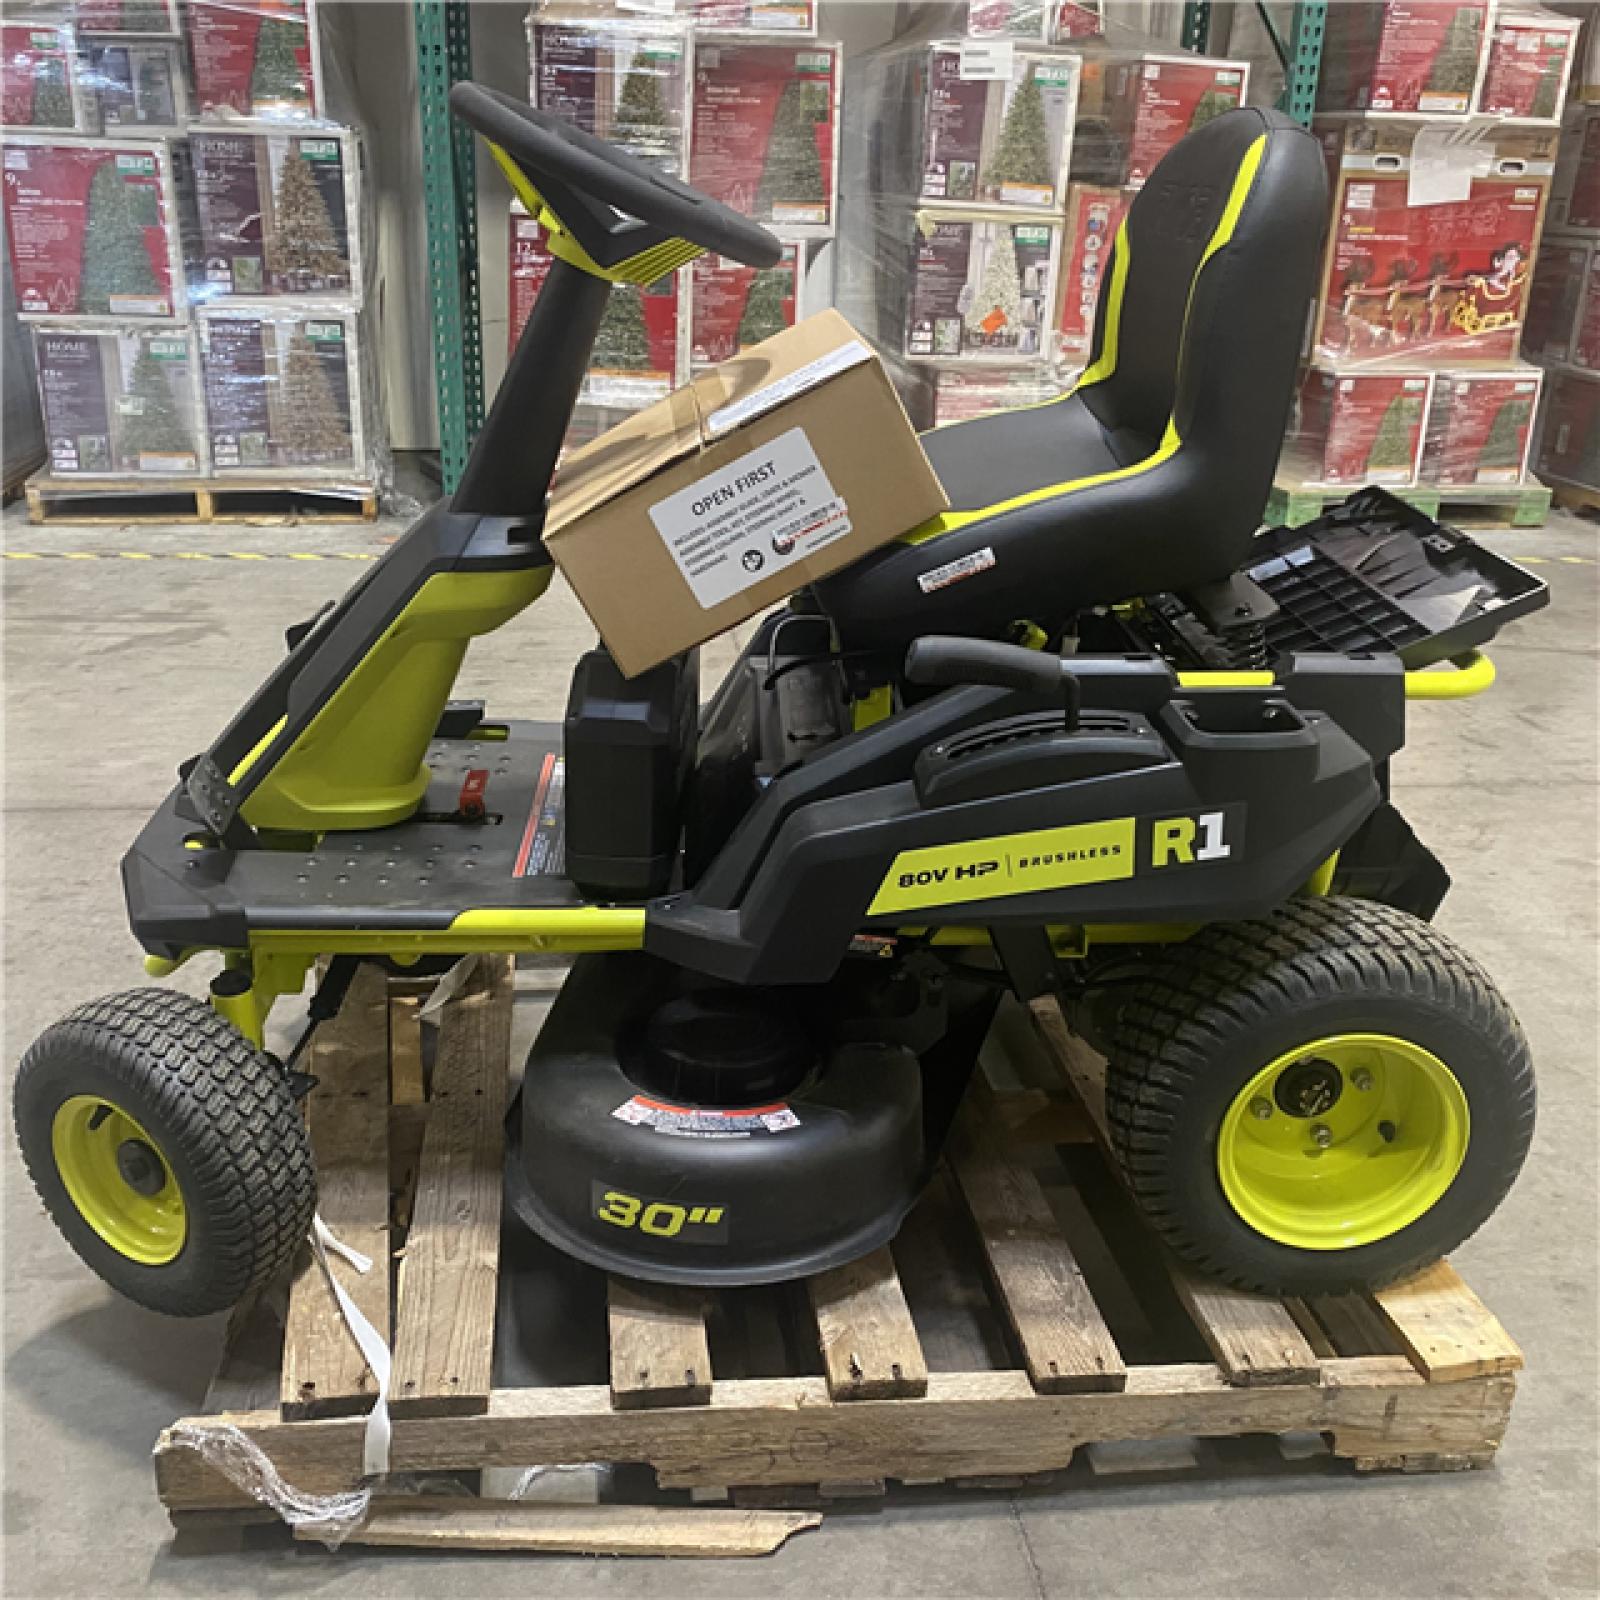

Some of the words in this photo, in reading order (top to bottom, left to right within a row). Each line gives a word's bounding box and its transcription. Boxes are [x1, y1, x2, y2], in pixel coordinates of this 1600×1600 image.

[691, 485, 735, 516] OPEN
[735, 460, 776, 493] FIRST
[1152, 812, 1231, 866] R1
[898, 867, 948, 888] 80V
[954, 861, 998, 881] HP
[1019, 845, 1121, 868] BRUSHLESS
